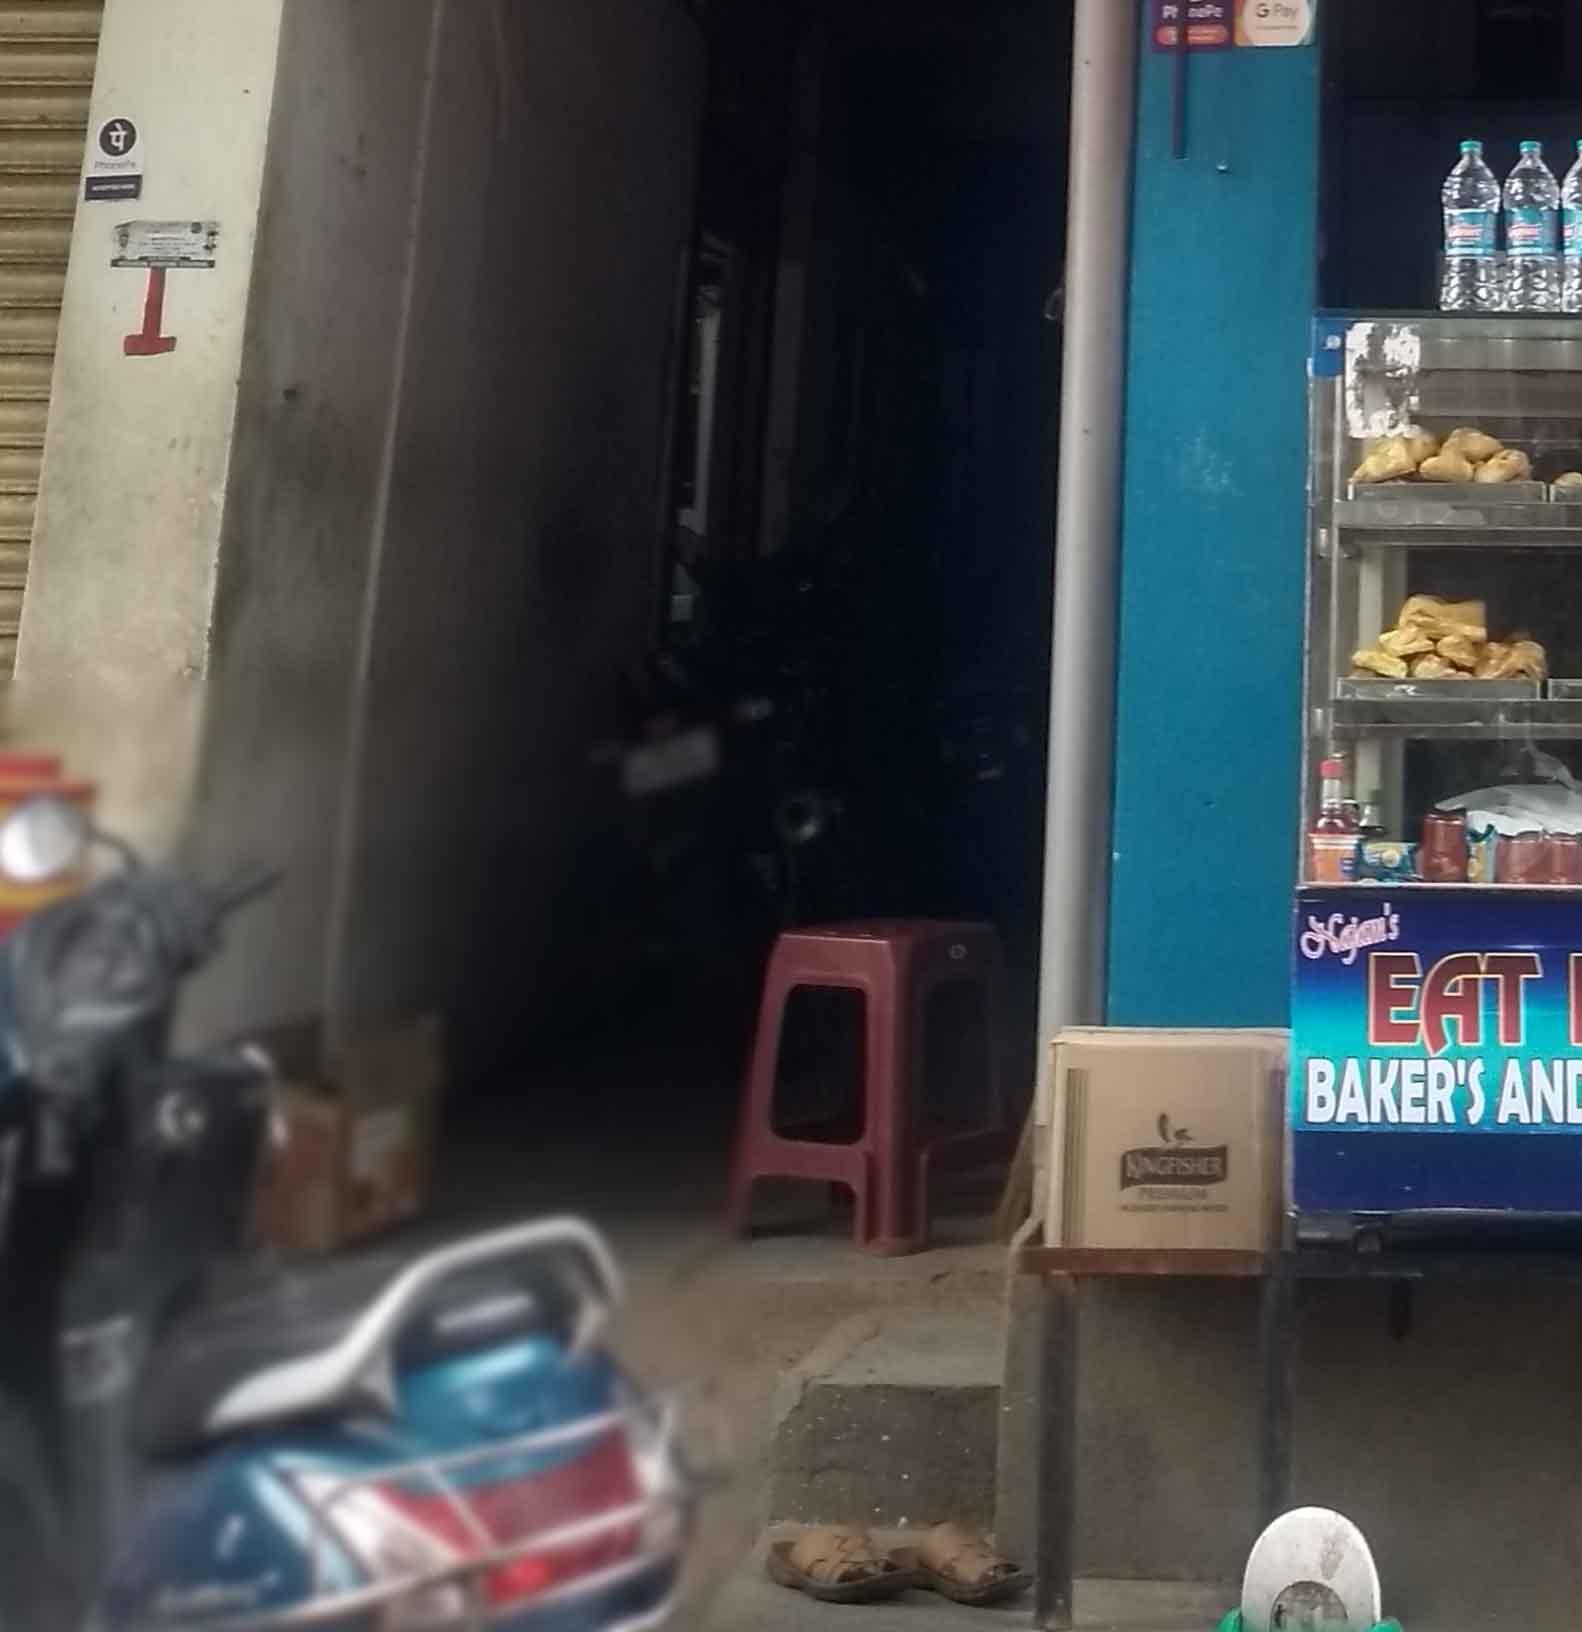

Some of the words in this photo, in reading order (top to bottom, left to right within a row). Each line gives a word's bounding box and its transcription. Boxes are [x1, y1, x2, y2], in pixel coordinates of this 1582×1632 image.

[1256, 3, 1270, 18] G
[1368, 951, 1543, 1056] EAT
[1306, 1058, 1486, 1126] BAKER'S
